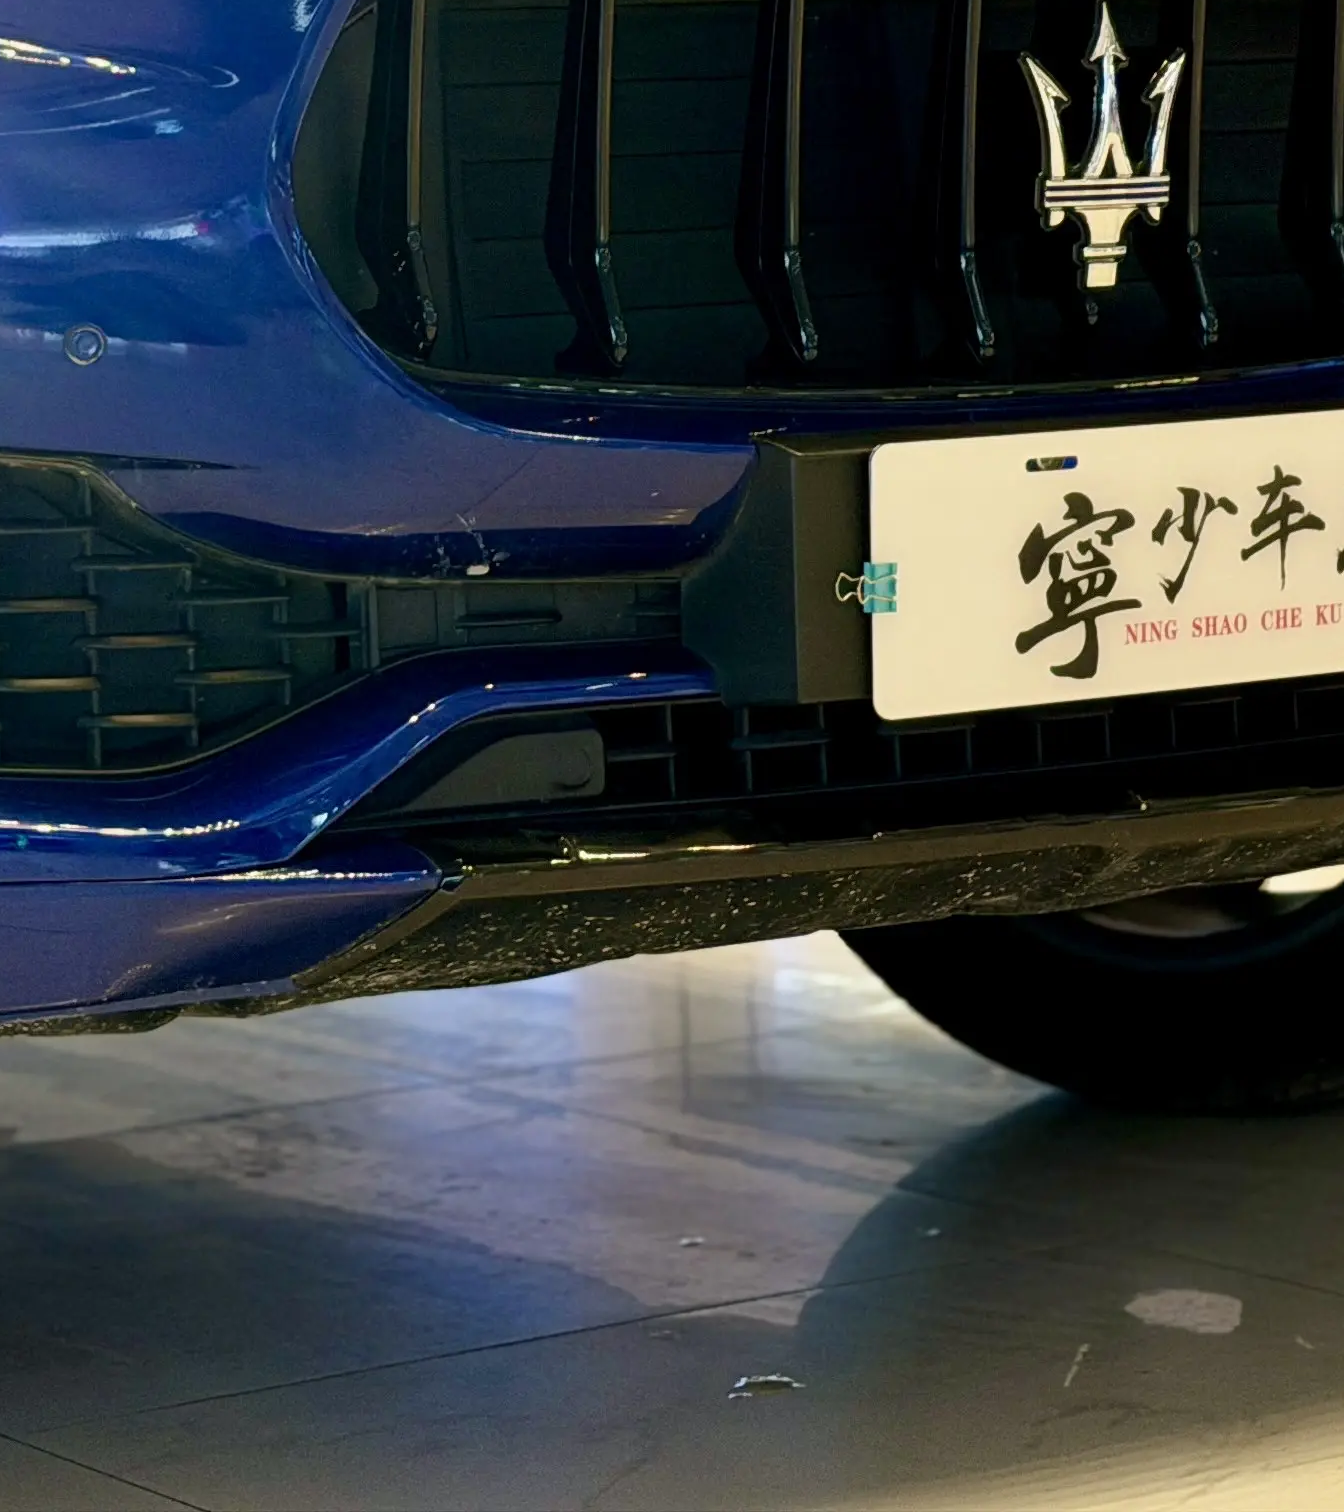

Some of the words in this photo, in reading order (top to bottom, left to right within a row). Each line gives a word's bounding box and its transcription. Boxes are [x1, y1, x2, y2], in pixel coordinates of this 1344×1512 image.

[1124, 620, 1178, 645] NING
[1192, 613, 1247, 638] SHAO
[1261, 607, 1302, 631] CHE
[1315, 602, 1343, 626] KU
